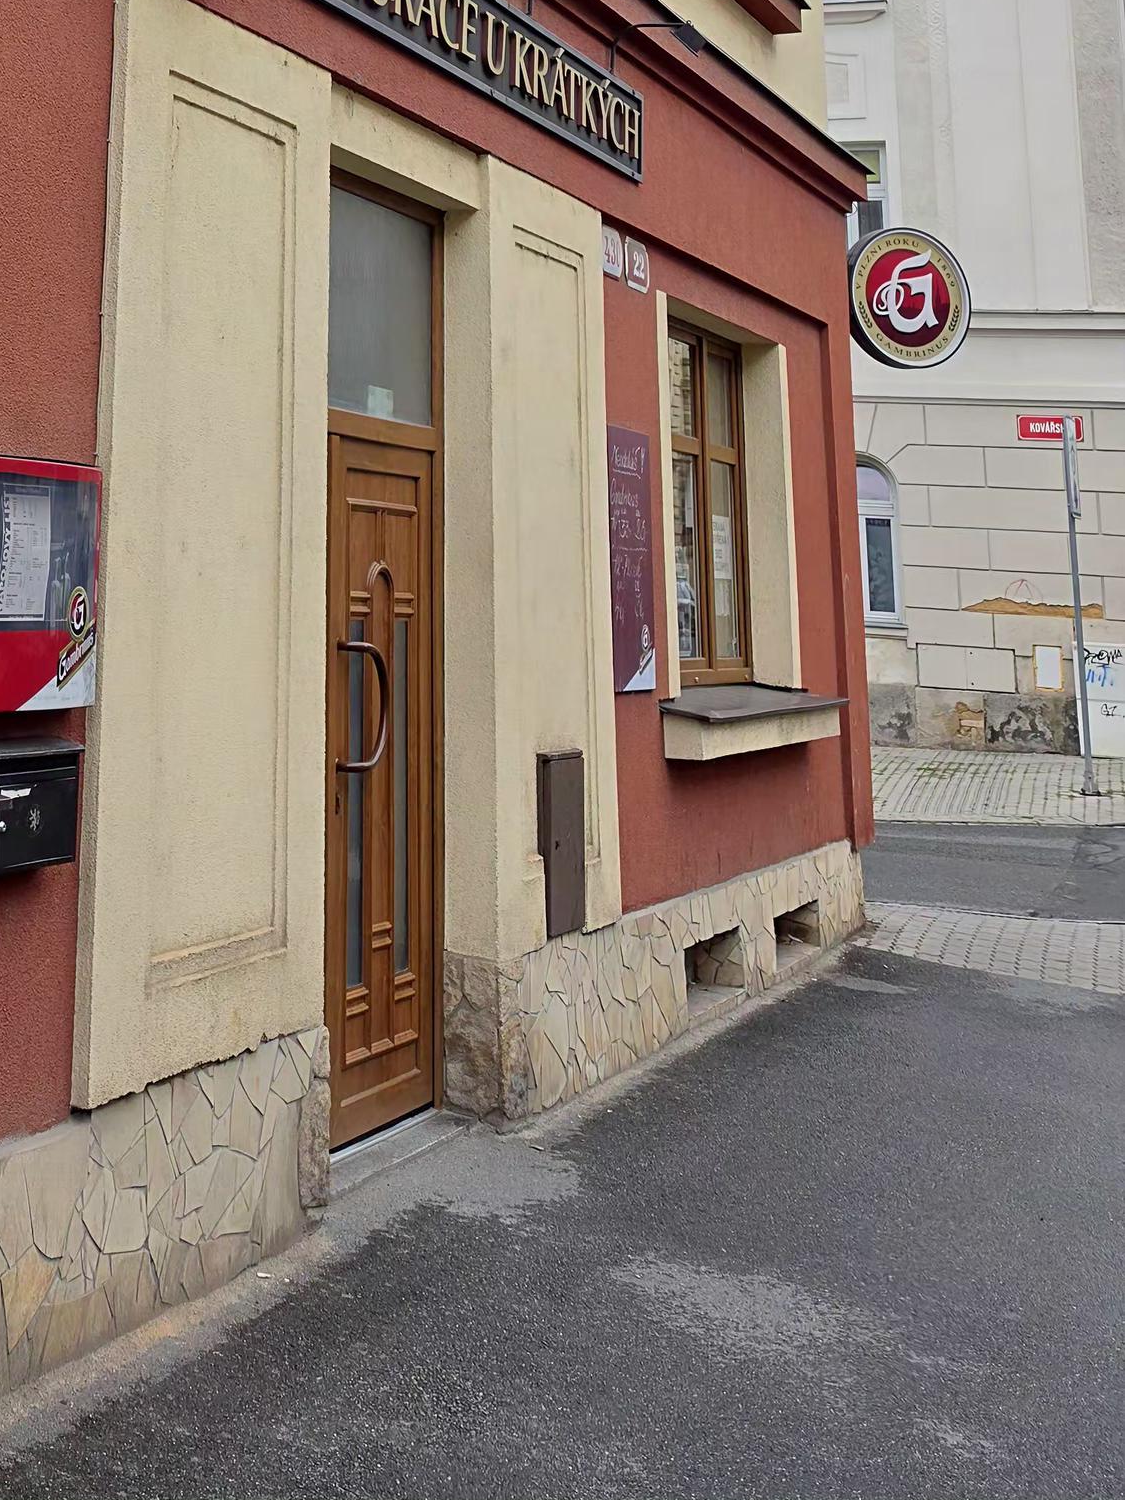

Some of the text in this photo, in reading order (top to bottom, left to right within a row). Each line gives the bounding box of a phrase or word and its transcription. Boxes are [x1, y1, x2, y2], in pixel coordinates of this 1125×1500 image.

[486, 11, 509, 76] U
[514, 47, 641, 159] KRÁTKÝCH
[633, 251, 645, 280] 22
[858, 244, 883, 278] PLZNI
[885, 237, 920, 249] ROKU
[937, 257, 956, 288] 1869
[876, 332, 949, 358] GAMBRINUS
[1029, 421, 1063, 434] KOVÁŘS
